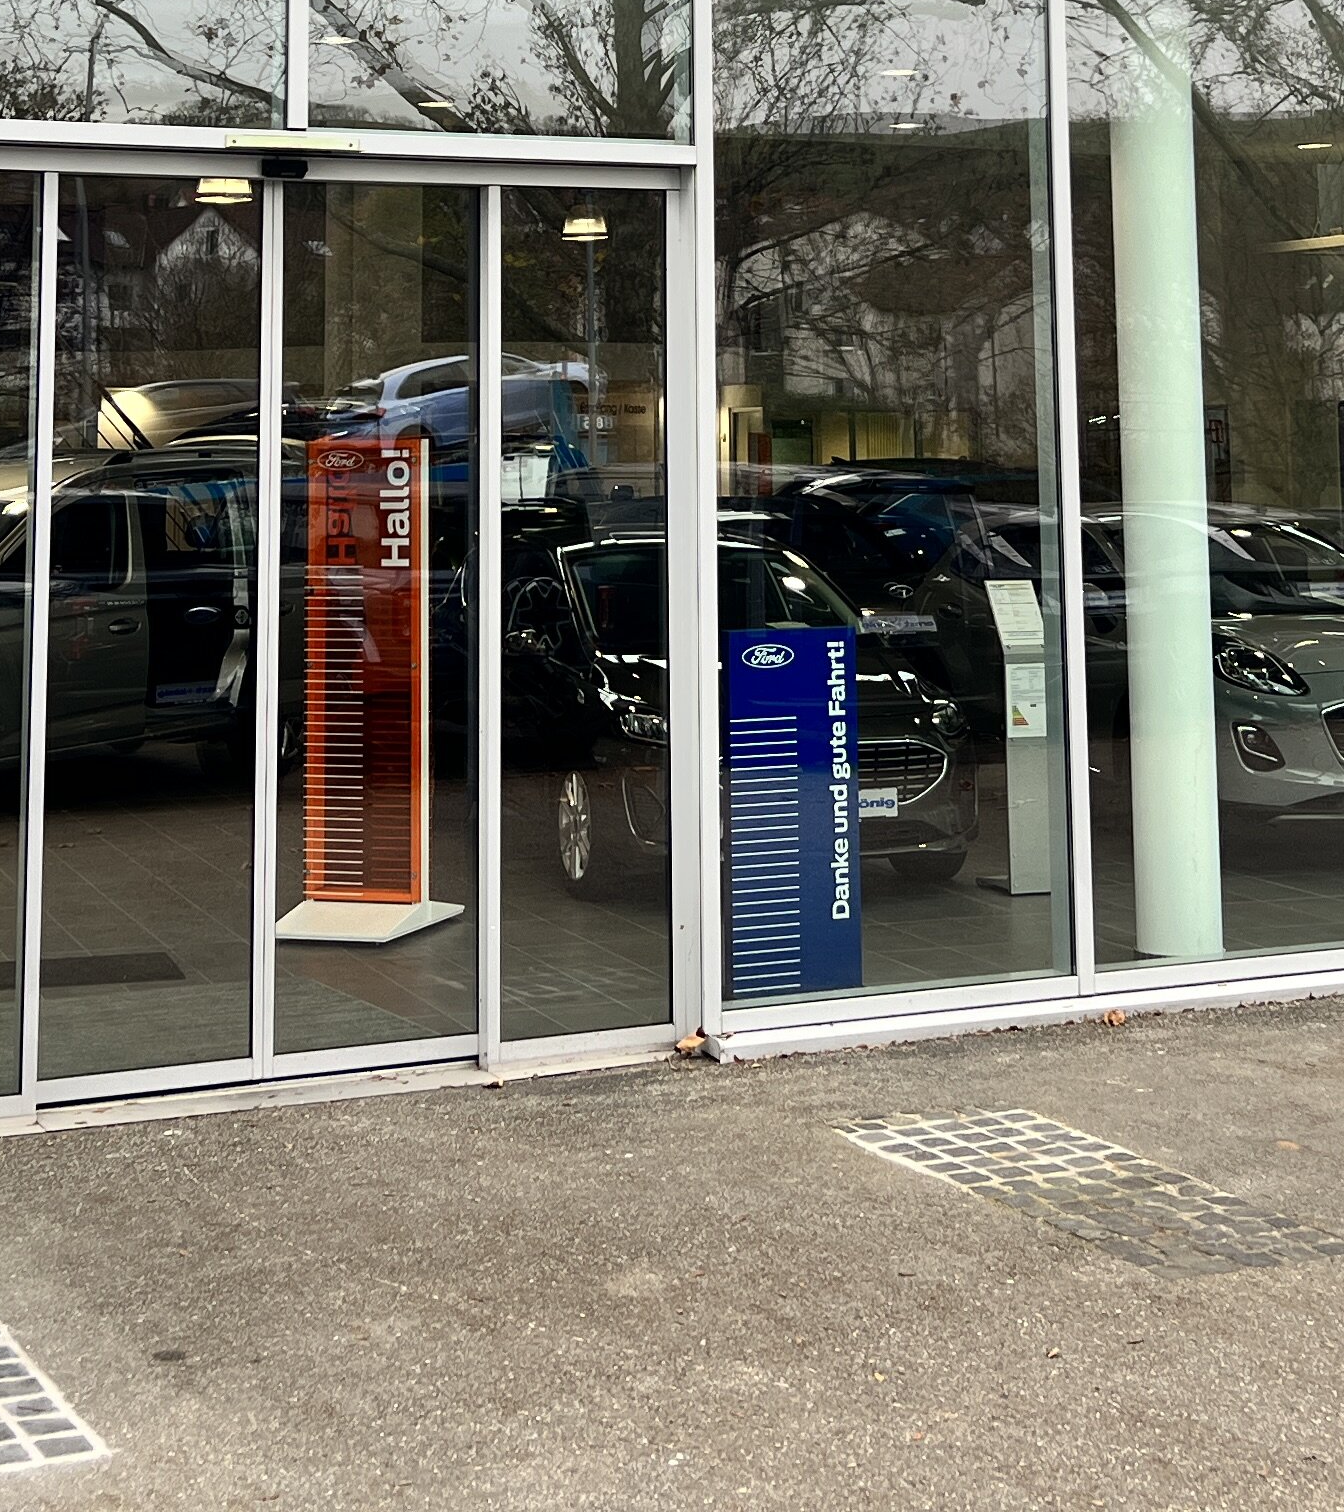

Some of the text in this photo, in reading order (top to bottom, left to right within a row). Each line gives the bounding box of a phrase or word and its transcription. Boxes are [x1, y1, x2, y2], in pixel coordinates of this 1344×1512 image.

[324, 452, 356, 468] Ford
[378, 448, 411, 567] Hallo!
[750, 646, 785, 665] Ford
[826, 640, 851, 920] Danke und gute Fahrt!
[858, 797, 896, 809] önig
